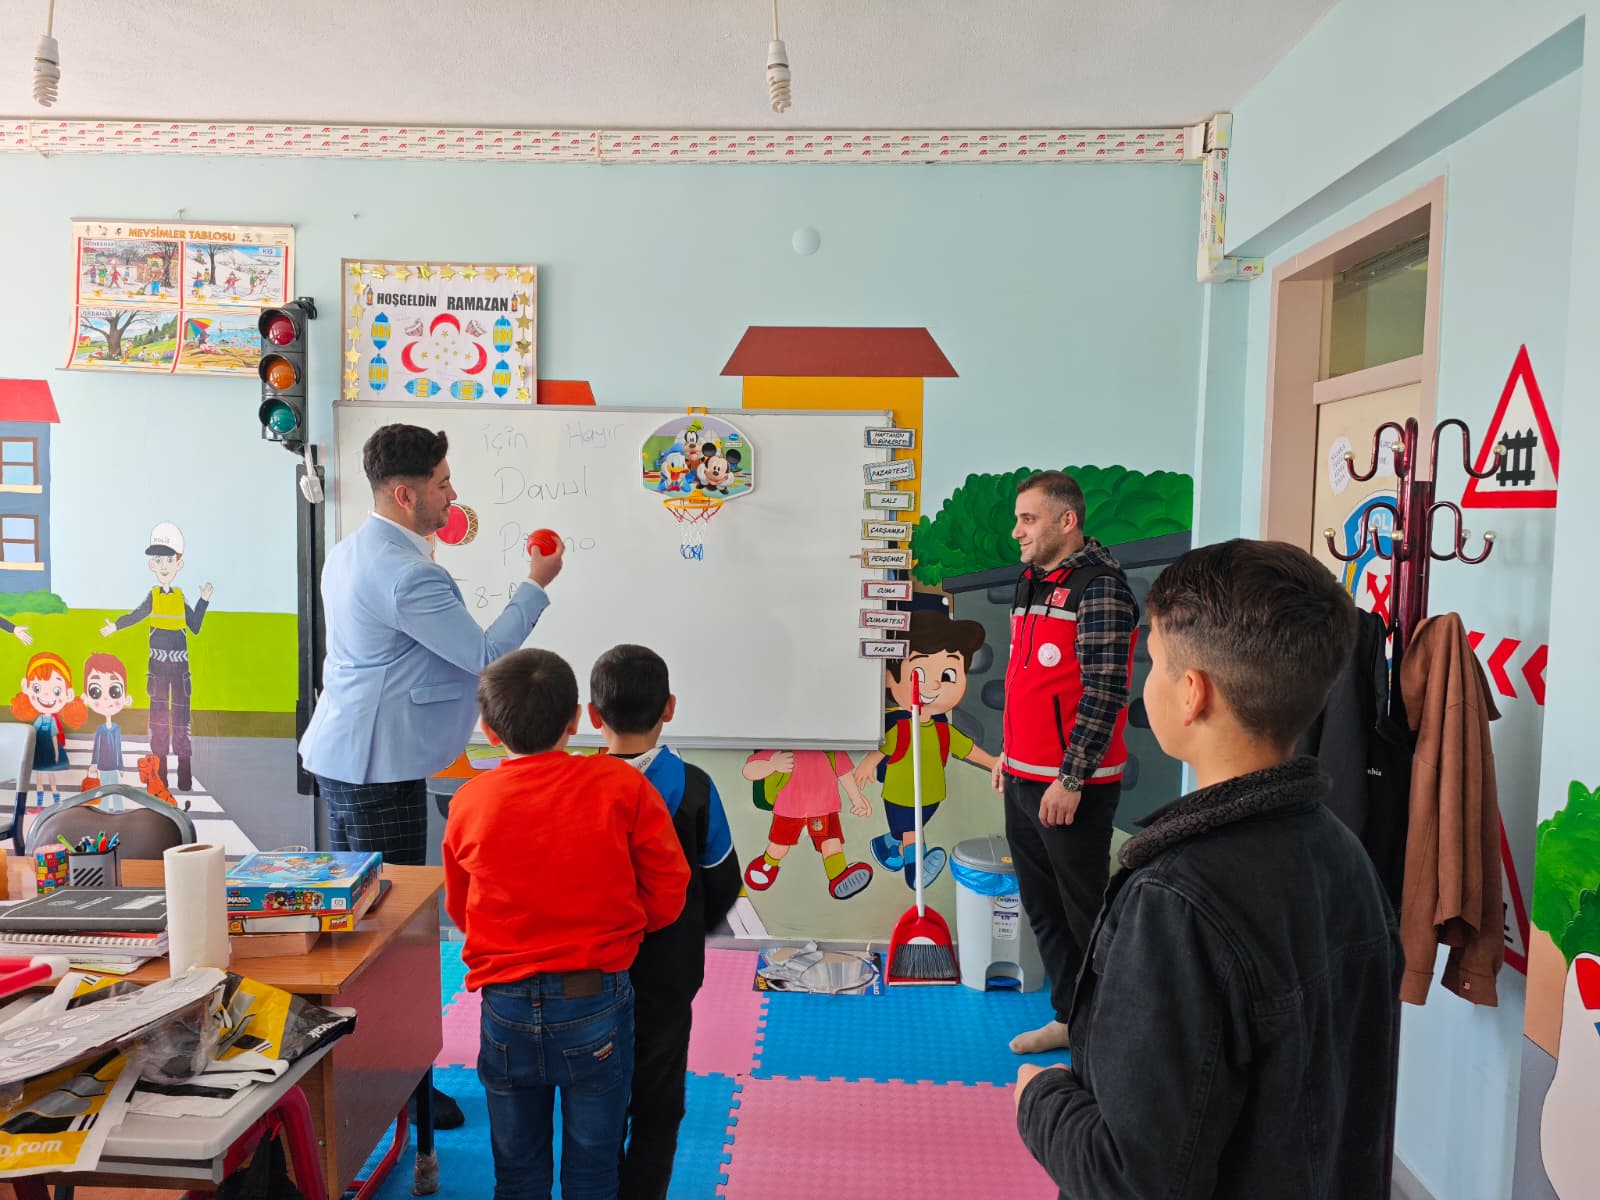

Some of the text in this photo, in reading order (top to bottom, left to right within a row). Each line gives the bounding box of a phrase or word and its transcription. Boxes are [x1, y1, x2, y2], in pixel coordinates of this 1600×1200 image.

[128, 226, 236, 242] MEVSİMLER TABLOSU
[376, 292, 509, 312] HOŞGELDİN RAMAZAN
[493, 464, 589, 505] Davul
[499, 520, 597, 567] Pino
